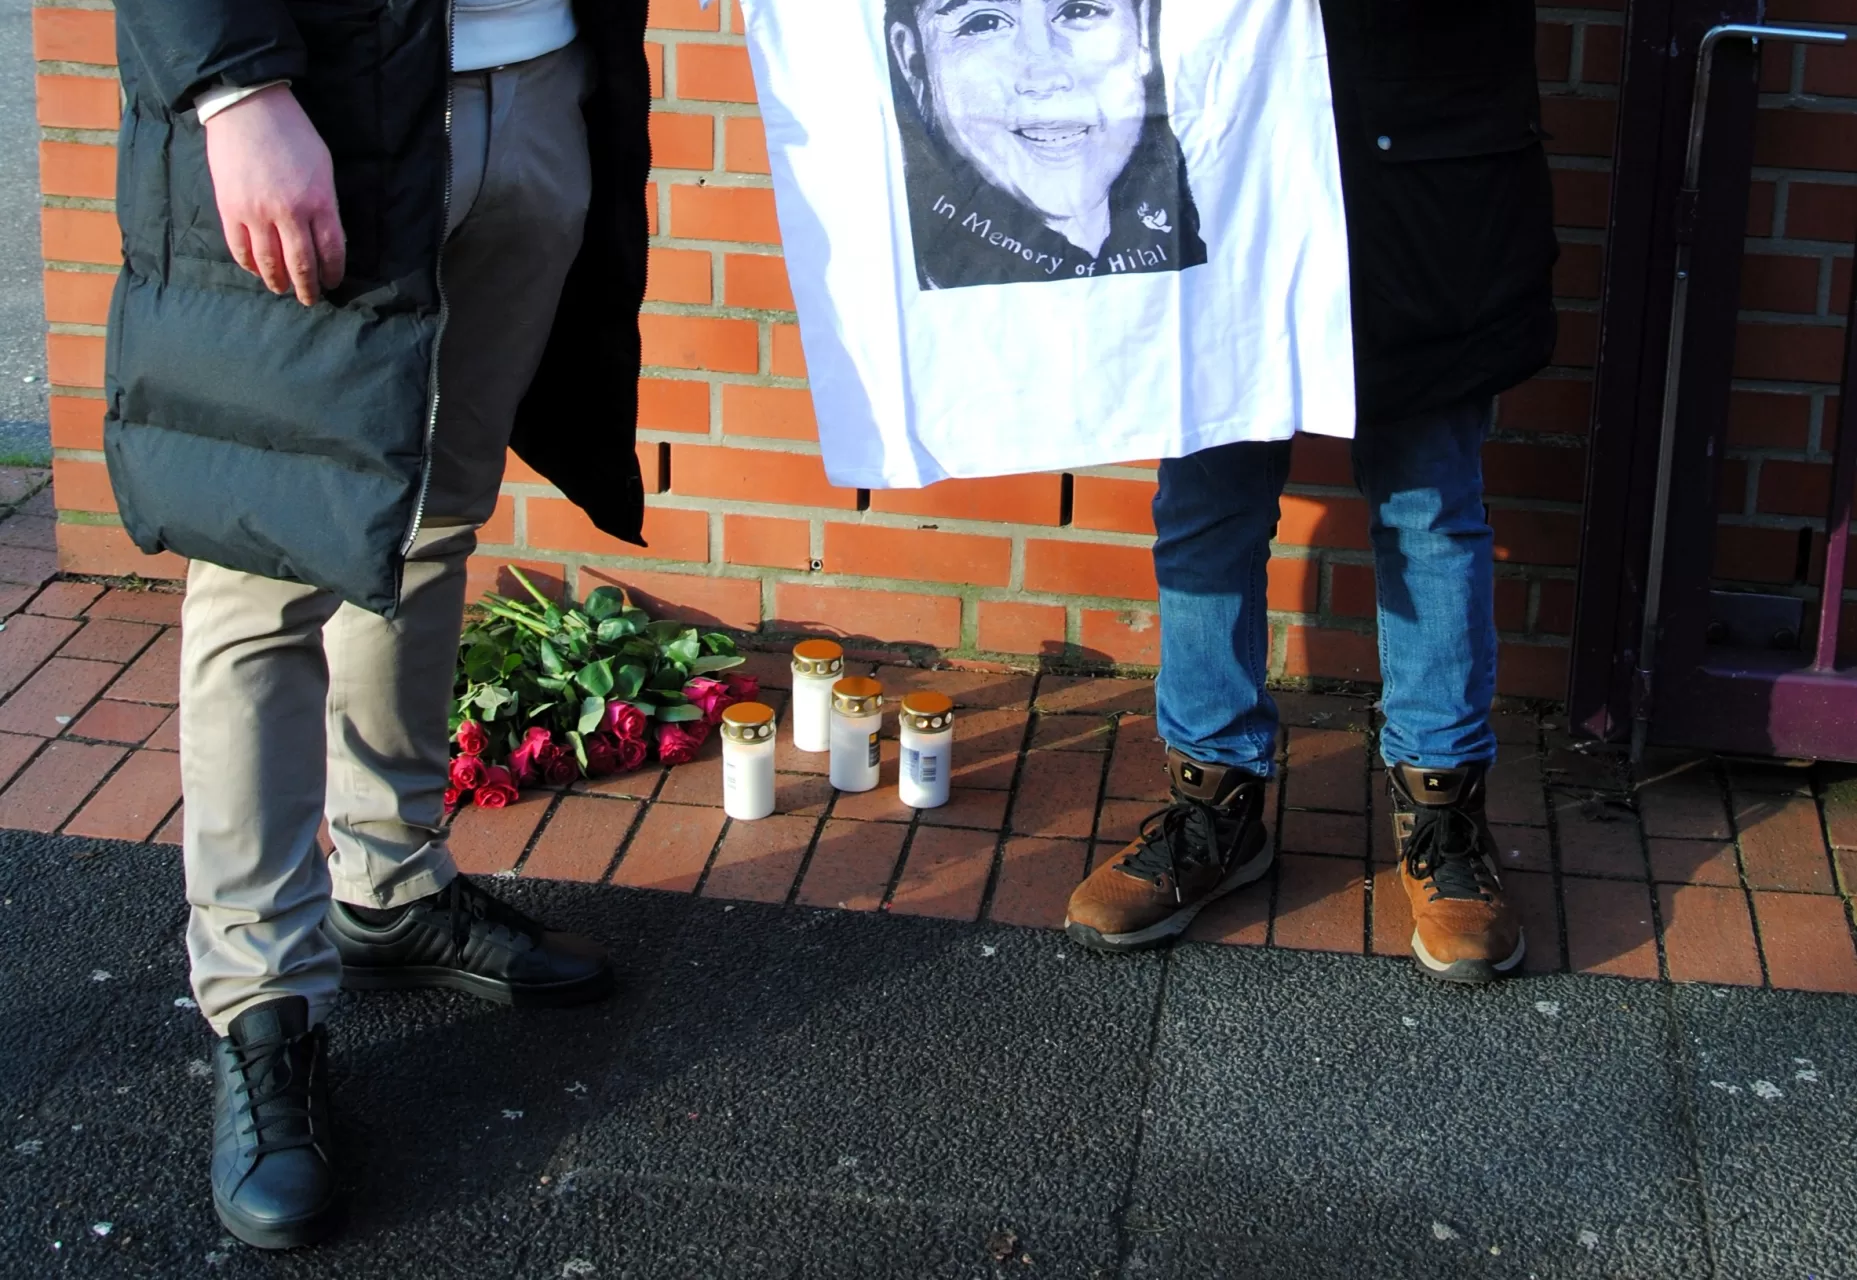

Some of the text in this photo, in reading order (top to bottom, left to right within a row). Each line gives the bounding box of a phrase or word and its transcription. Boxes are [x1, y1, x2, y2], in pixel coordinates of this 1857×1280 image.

[932, 194, 1168, 277] In Memory of Hilal
